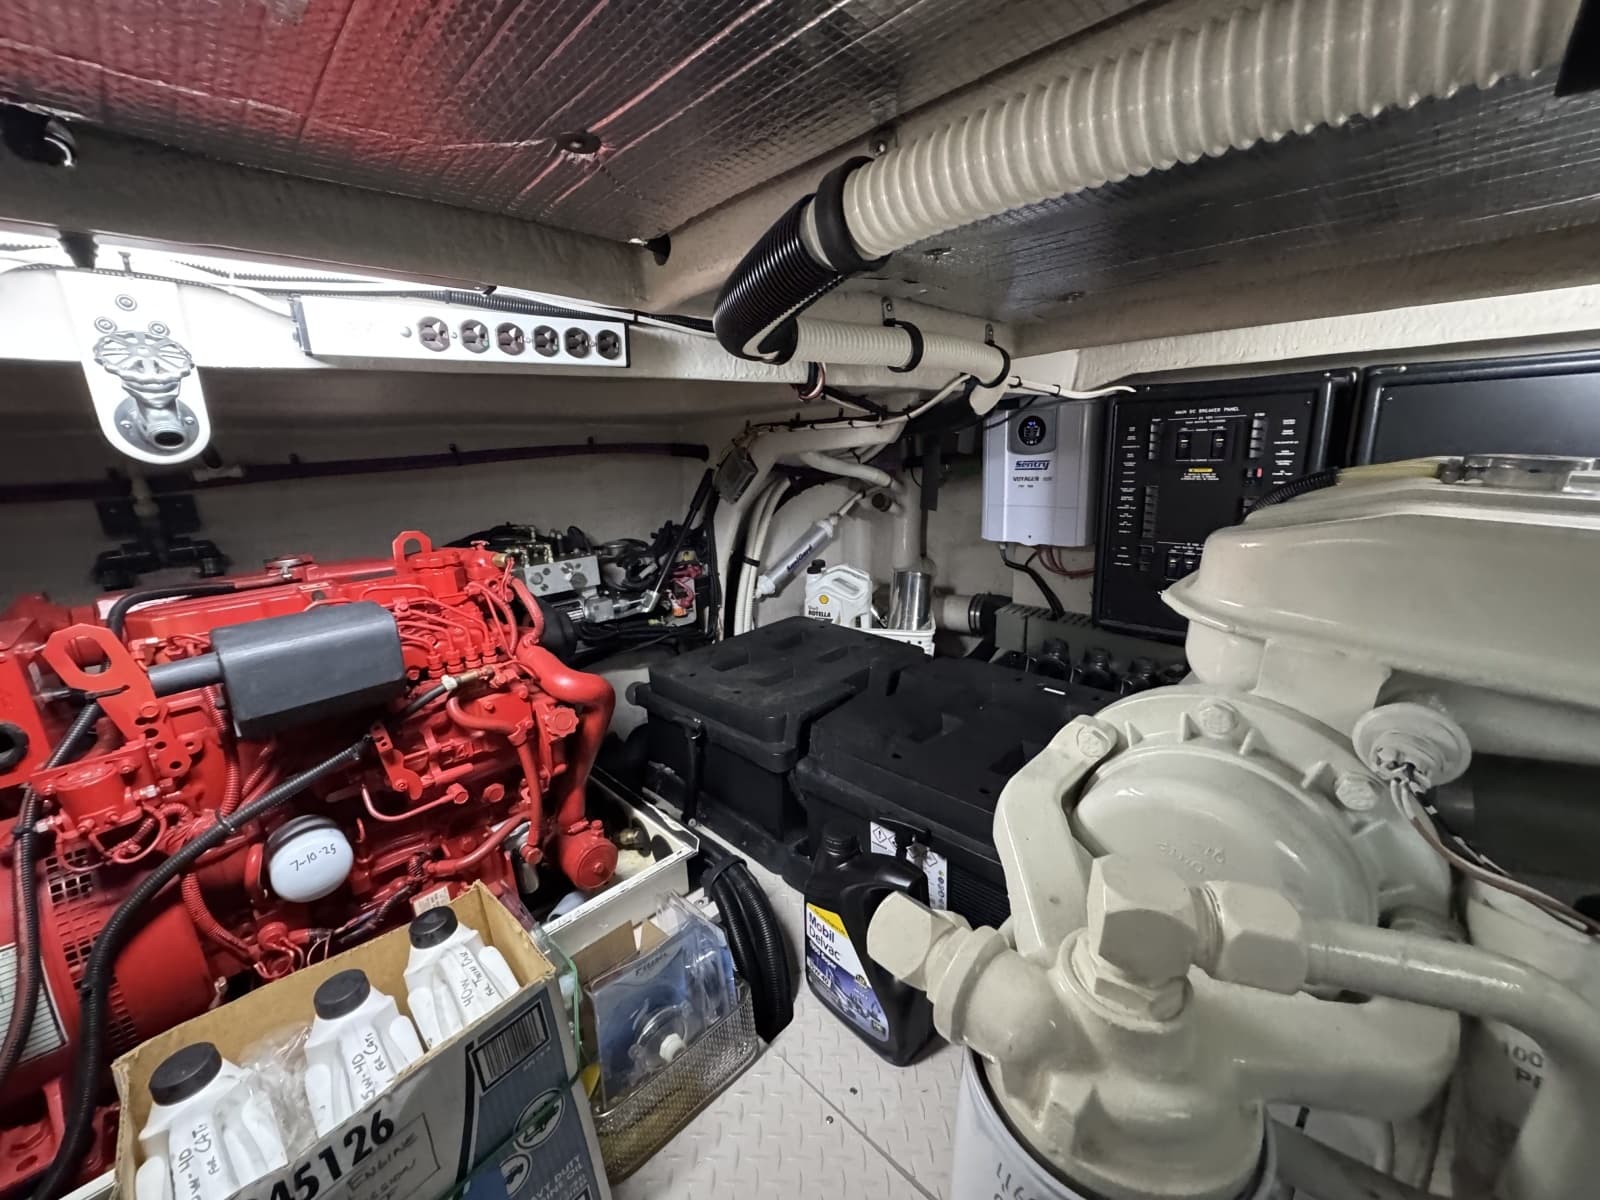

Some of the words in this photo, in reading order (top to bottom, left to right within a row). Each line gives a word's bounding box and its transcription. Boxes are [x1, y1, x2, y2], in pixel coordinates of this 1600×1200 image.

[1014, 460, 1050, 470] Sentry
[808, 610, 831, 618] ROTELLA
[290, 843, 337, 872] 7-10-25
[809, 912, 835, 944] Mobil
[809, 928, 841, 961] Delvac
[554, 1154, 579, 1183] DUTY
